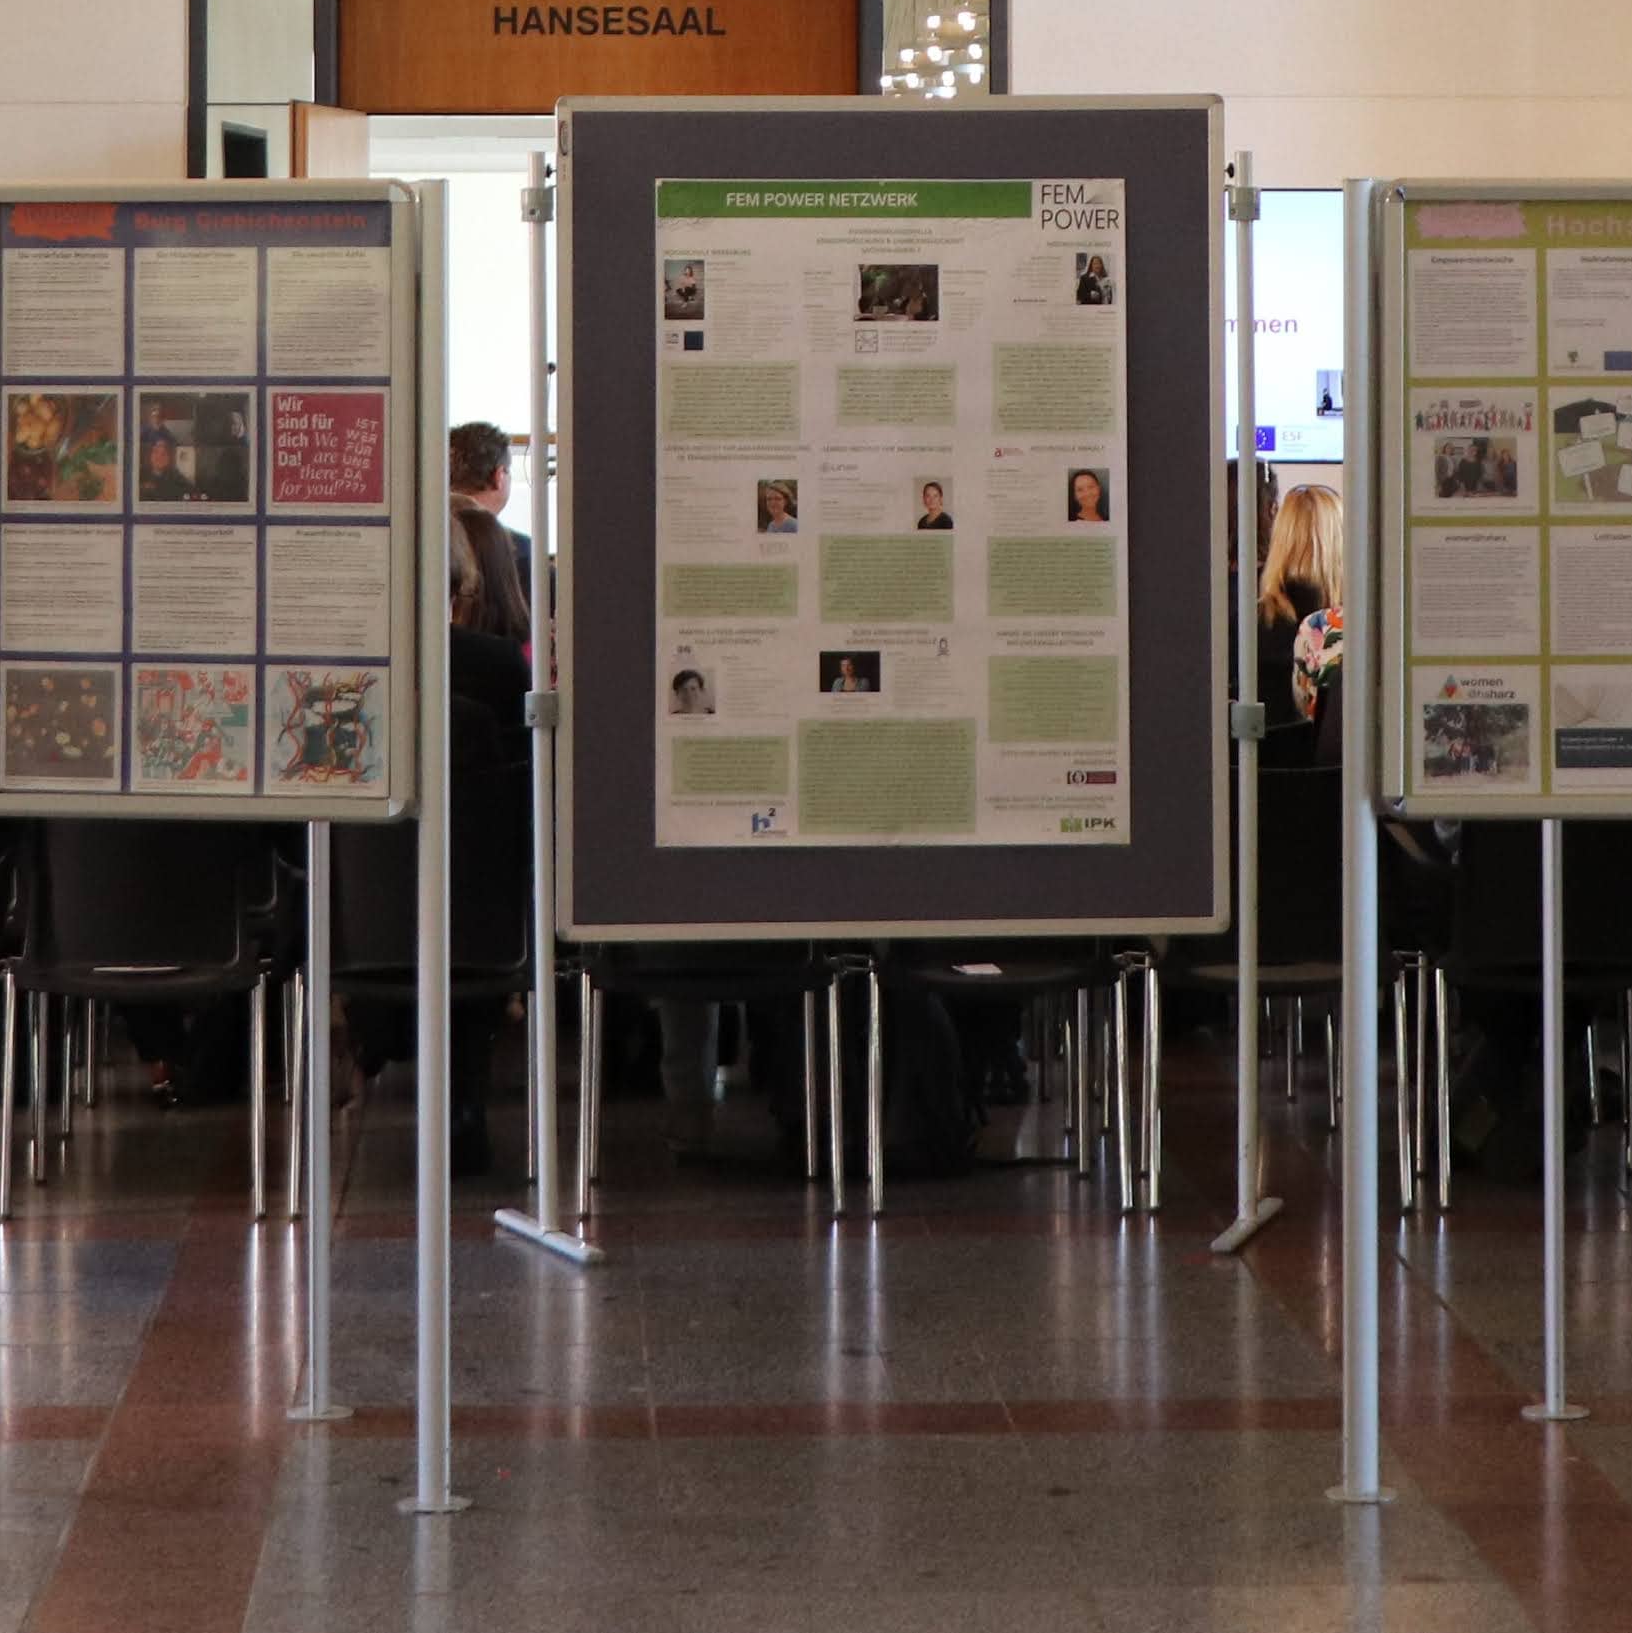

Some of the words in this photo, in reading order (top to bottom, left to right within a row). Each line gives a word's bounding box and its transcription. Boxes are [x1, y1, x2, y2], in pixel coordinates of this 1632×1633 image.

[491, 5, 726, 36] HANSESAAL
[725, 192, 760, 207] FEM
[763, 192, 825, 207] POWER
[828, 192, 918, 207] NETZWERK
[1040, 184, 1086, 205] FEM
[1040, 209, 1120, 230] POWER
[278, 396, 303, 412] Wir
[277, 414, 308, 429] sind
[312, 413, 335, 429] für
[356, 417, 379, 431] IST
[277, 431, 309, 448] dich
[315, 431, 339, 447] We
[278, 450, 303, 467] Da!
[313, 451, 337, 464] are
[300, 464, 338, 480] there
[276, 479, 303, 500] for
[1460, 677, 1504, 688] women
[1084, 817, 1117, 829] IPK
